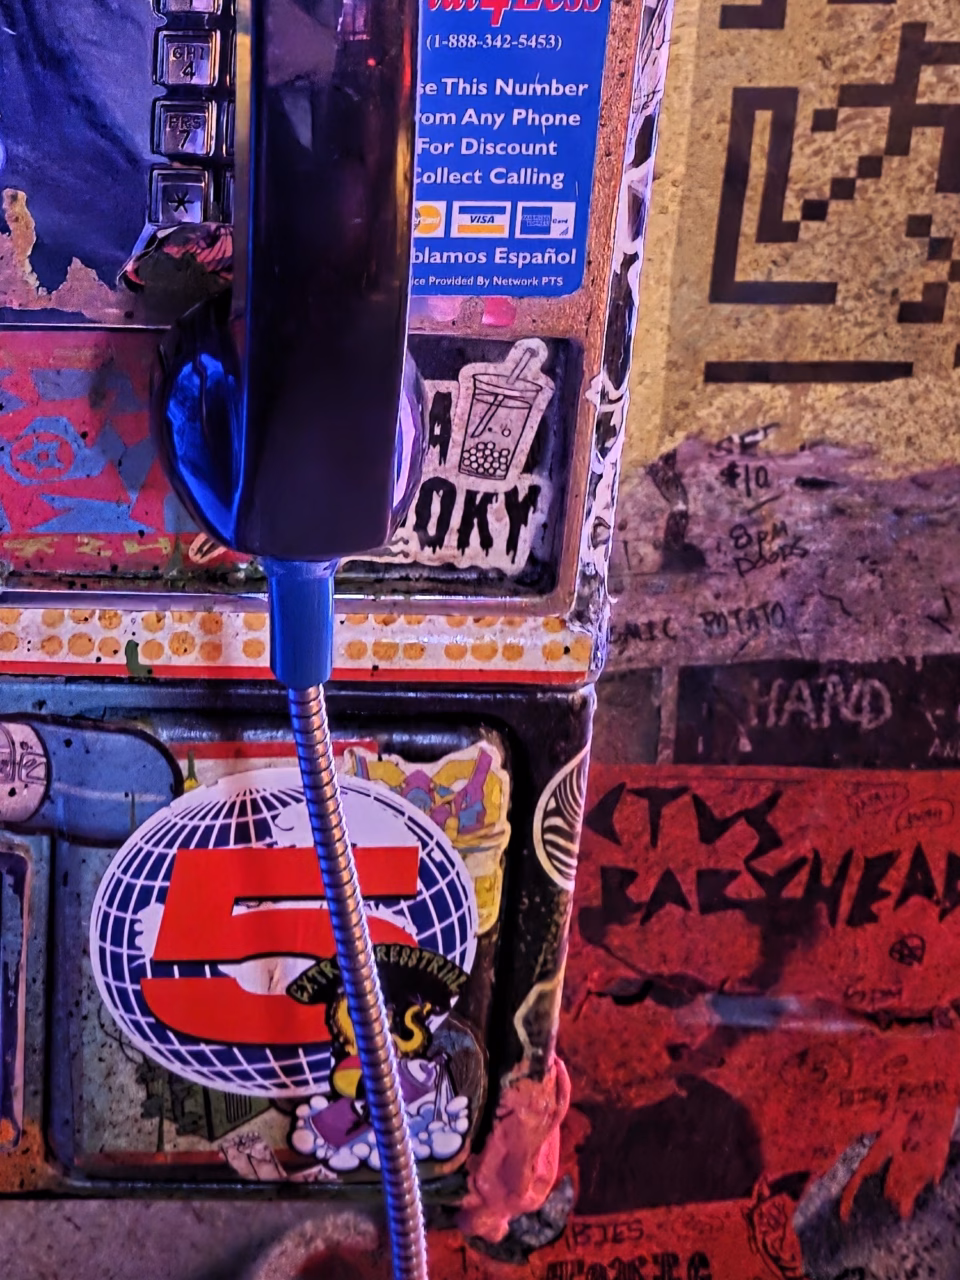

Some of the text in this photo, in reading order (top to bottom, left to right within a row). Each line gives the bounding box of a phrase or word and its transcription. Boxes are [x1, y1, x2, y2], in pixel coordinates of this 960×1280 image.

[426, 33, 563, 52] (1-888-342-5453)
[172, 46, 205, 61] GHI
[180, 61, 196, 83] 4
[441, 77, 589, 97] This Number
[460, 107, 582, 131] Any Phone
[177, 130, 191, 150] 7
[416, 137, 558, 156] For Discount
[489, 167, 566, 191] Calling
[469, 214, 495, 225] VISA
[494, 246, 577, 269] Español
[429, 275, 565, 289] Provided By Network PTS
